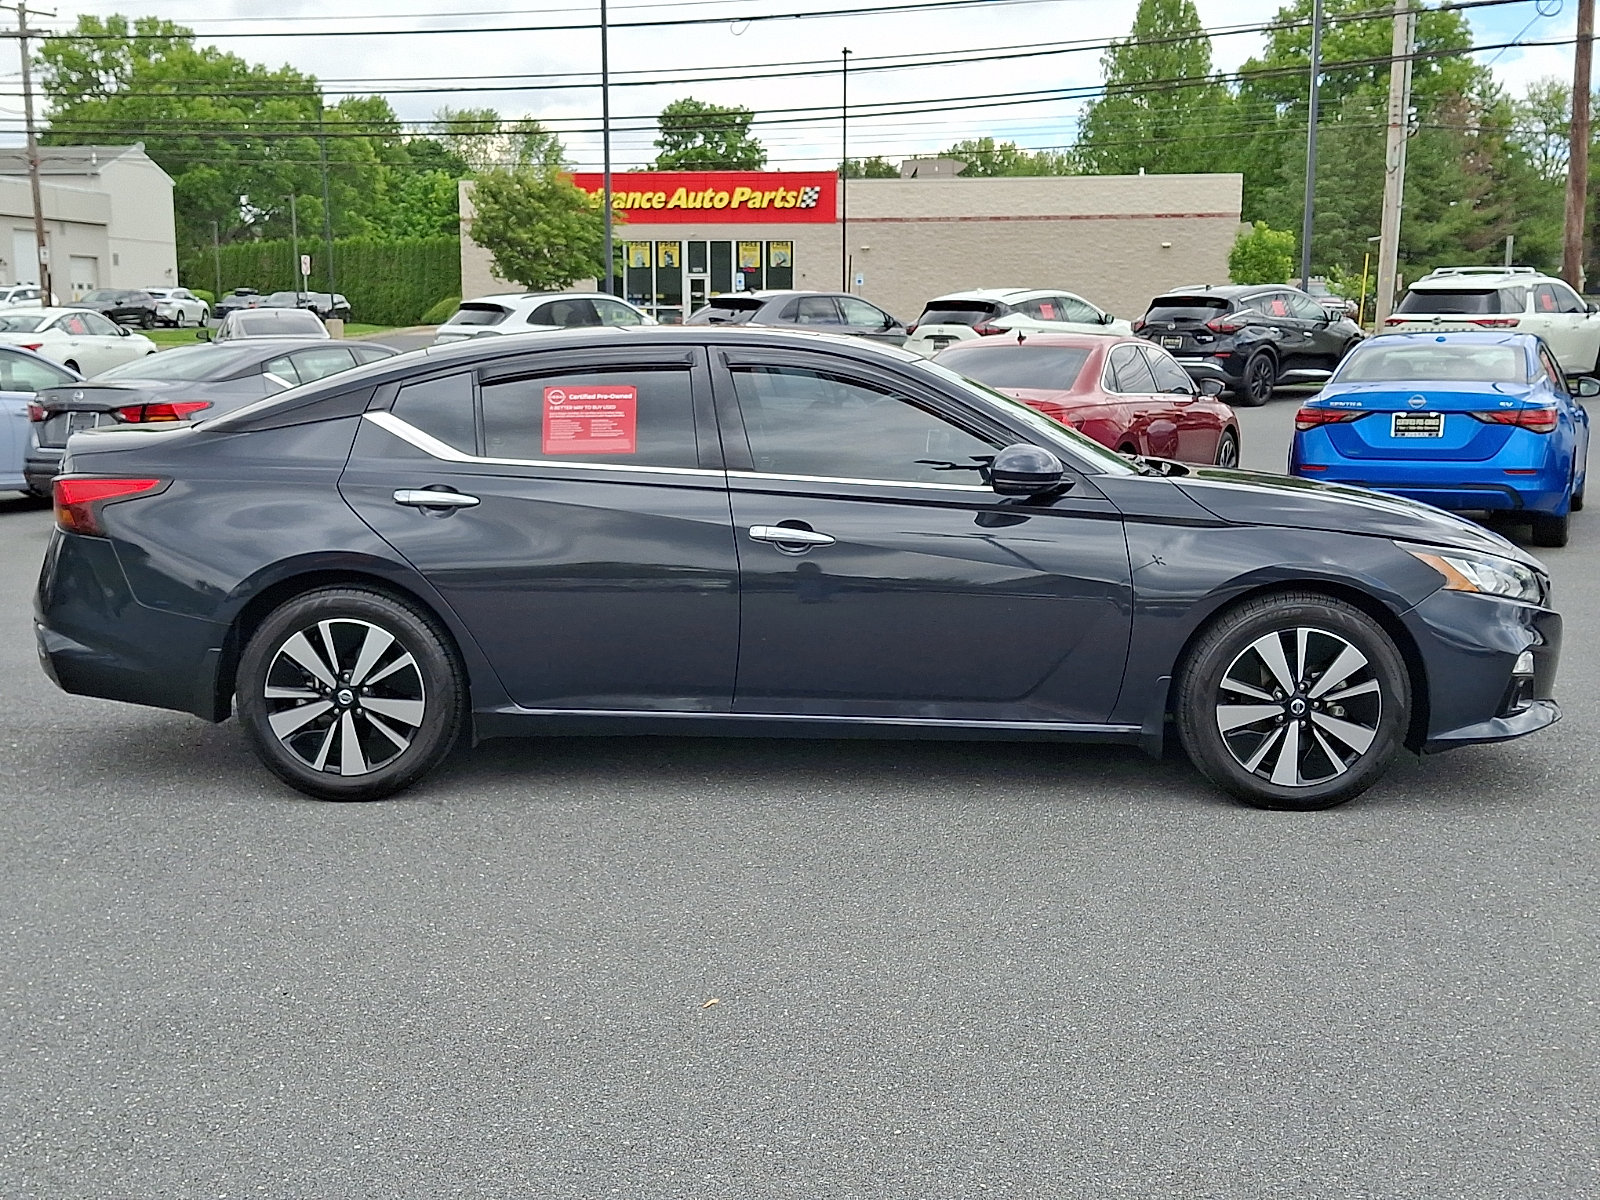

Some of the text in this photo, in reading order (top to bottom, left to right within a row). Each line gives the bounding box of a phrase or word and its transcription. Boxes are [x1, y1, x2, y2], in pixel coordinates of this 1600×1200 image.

[578, 186, 798, 209] dance Auto Parts
